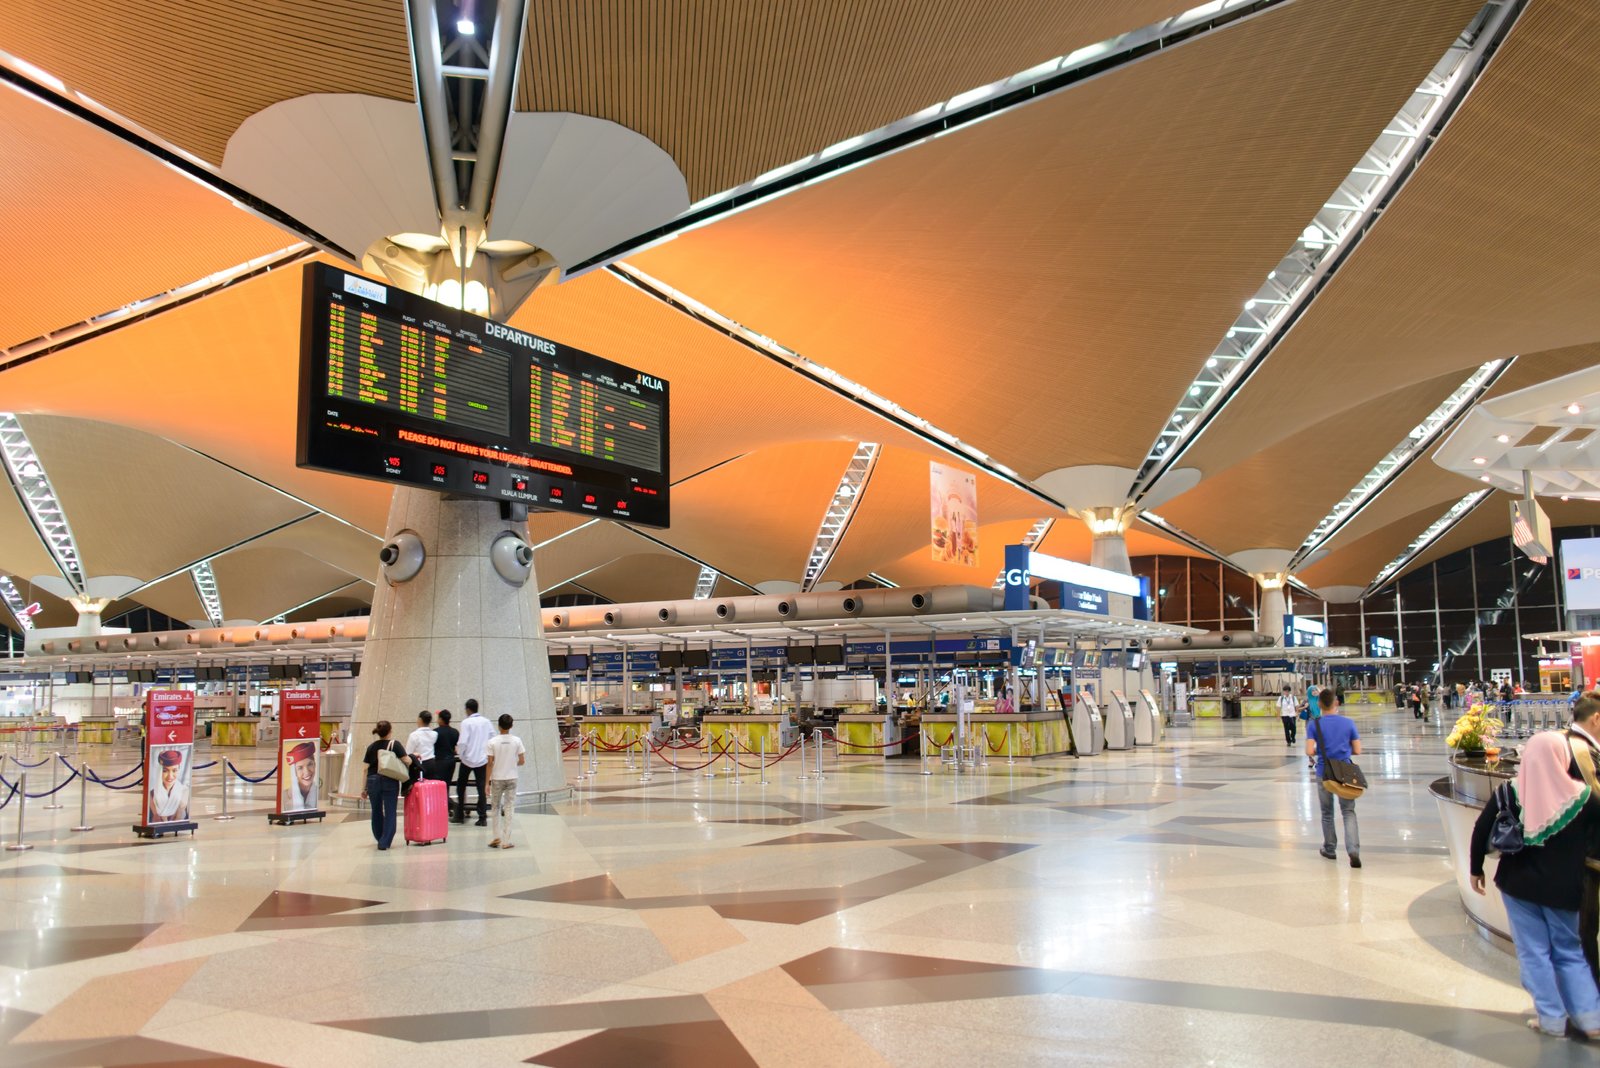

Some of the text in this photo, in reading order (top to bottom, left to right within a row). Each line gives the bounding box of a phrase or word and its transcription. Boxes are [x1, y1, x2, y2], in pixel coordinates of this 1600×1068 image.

[484, 322, 556, 356] DEPARTURES
[642, 374, 663, 392] KLIA
[398, 430, 573, 475] PLEASE DO NOT LEAVE YOUR LUGGAGE UNATTENDED.
[501, 489, 538, 501] KUALA LUMPUR
[1006, 569, 1022, 586] G
[1023, 569, 1030, 586] G
[1286, 626, 1291, 635] J
